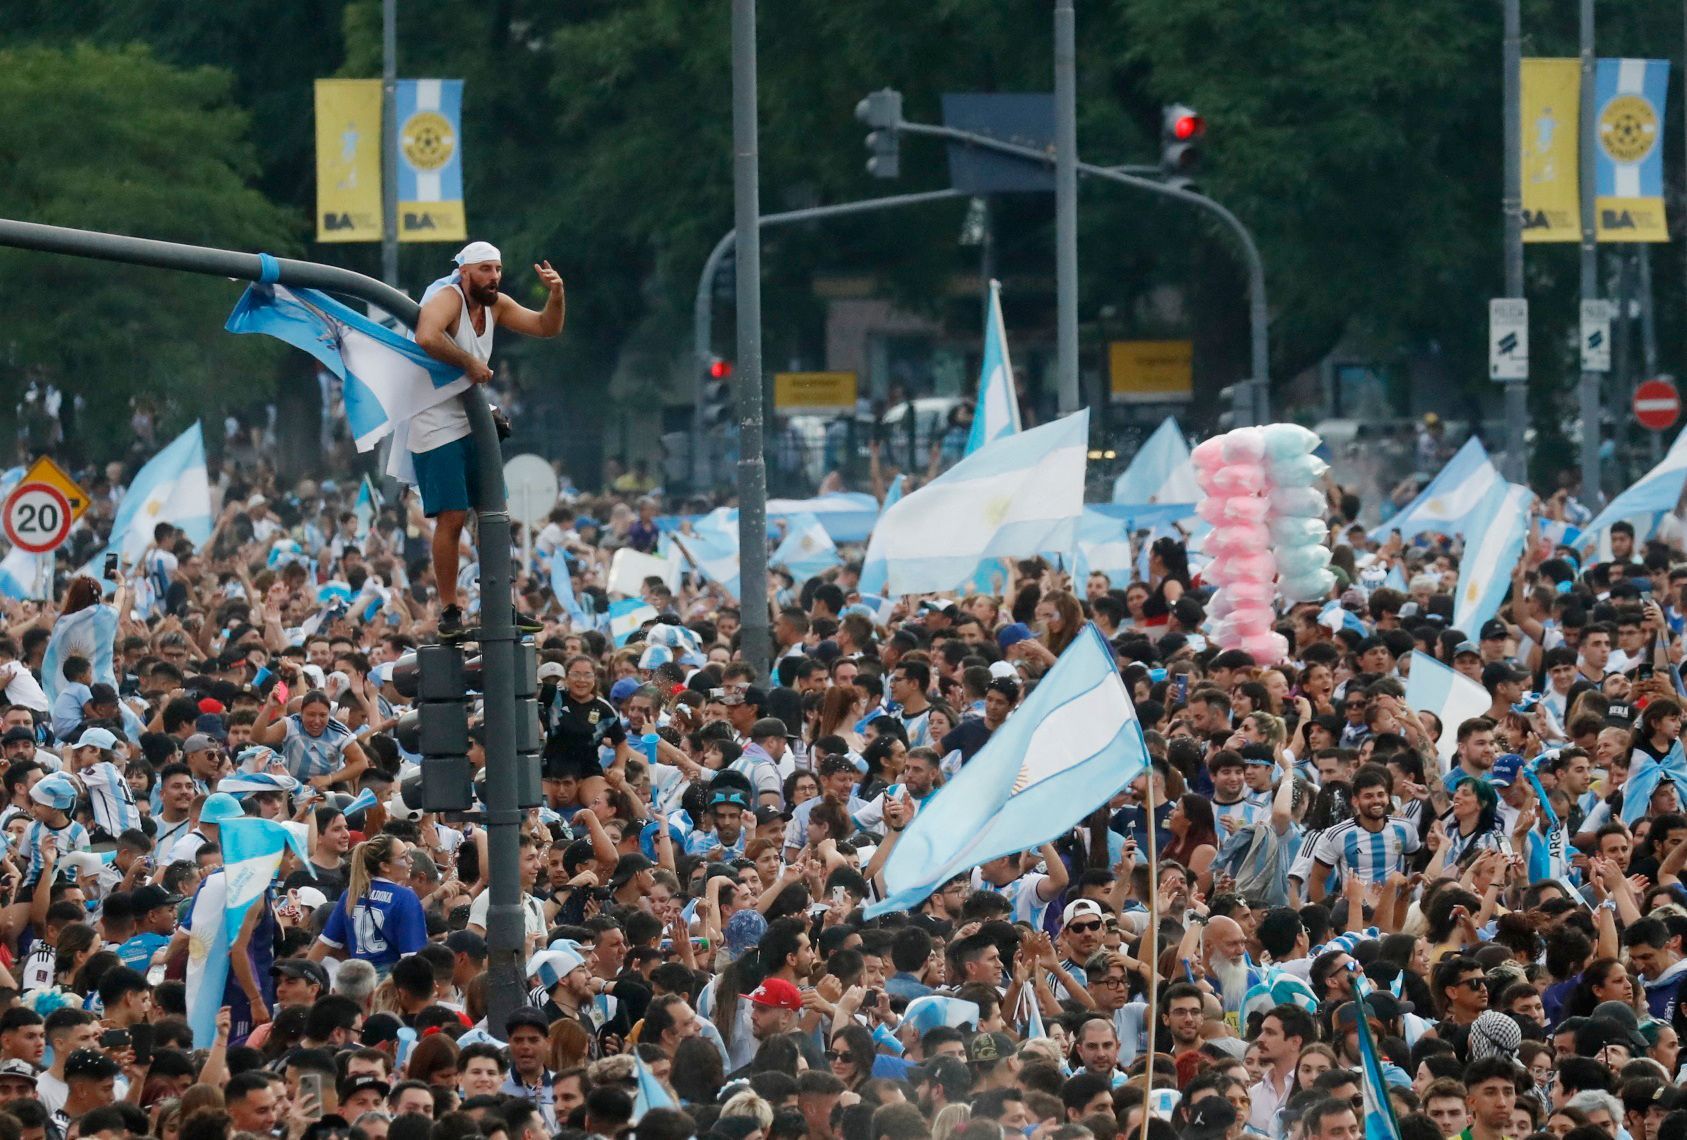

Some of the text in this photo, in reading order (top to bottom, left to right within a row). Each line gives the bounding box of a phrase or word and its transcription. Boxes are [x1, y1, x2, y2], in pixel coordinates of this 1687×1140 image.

[324, 212, 354, 230] BA
[404, 212, 435, 230] BA
[1602, 210, 1634, 229] BA
[18, 504, 58, 532] 20
[352, 904, 389, 953] 10
